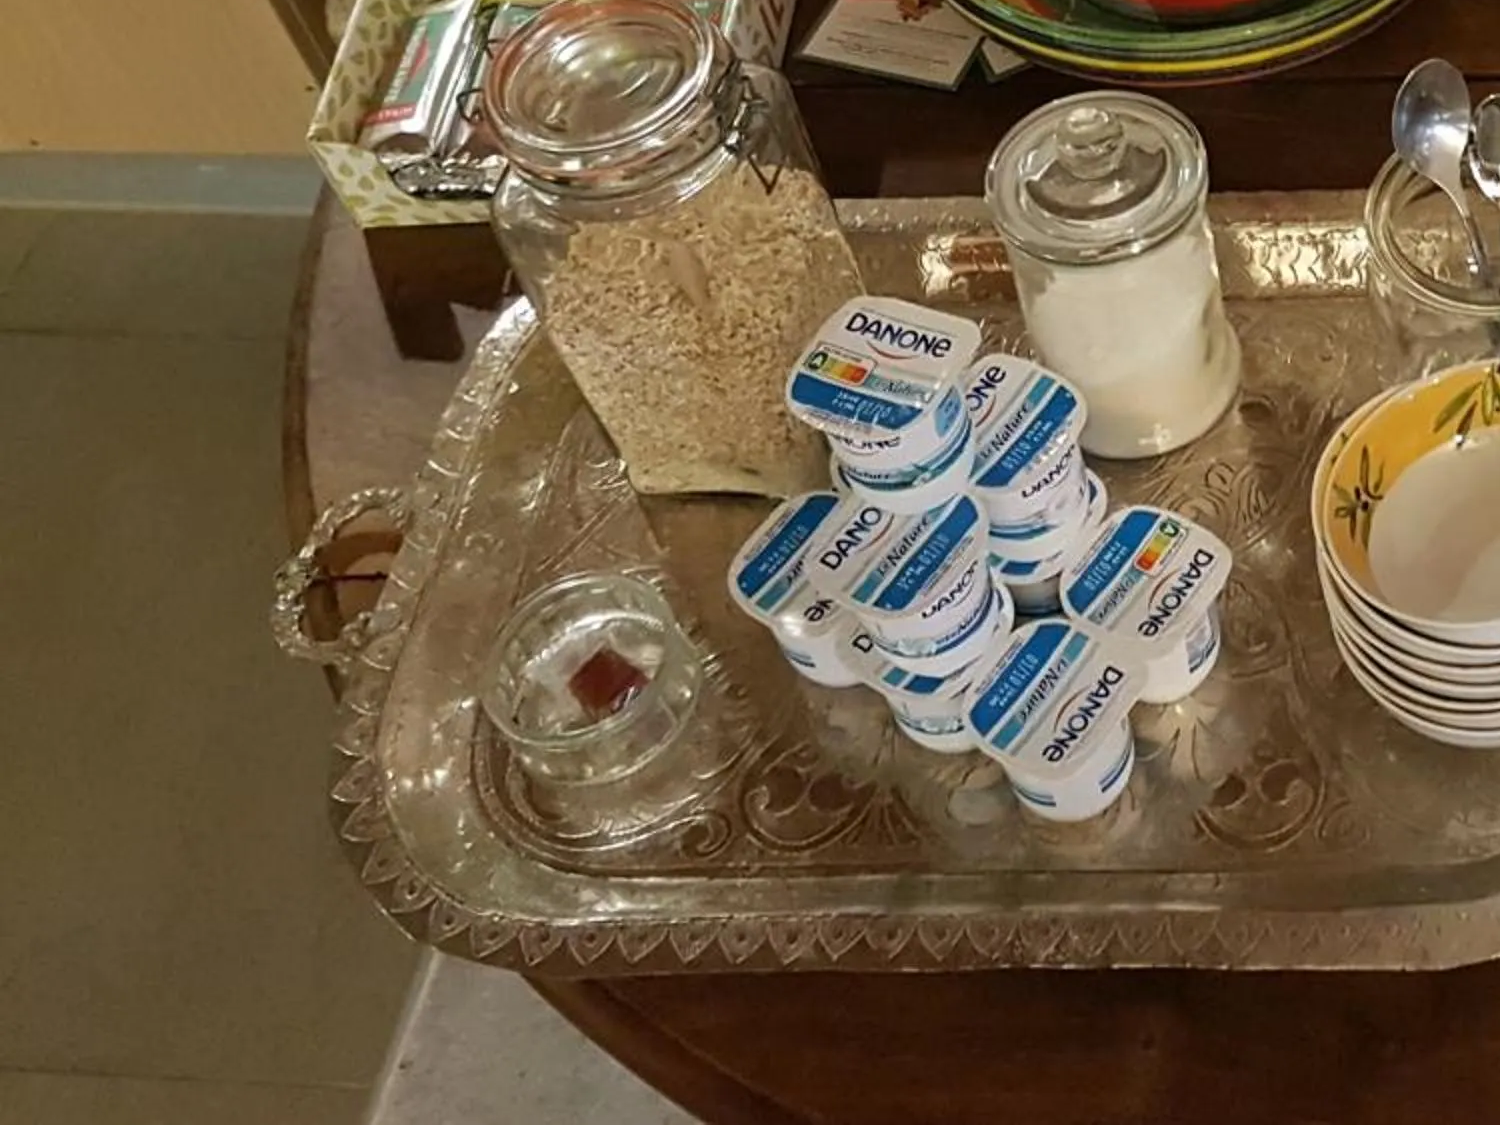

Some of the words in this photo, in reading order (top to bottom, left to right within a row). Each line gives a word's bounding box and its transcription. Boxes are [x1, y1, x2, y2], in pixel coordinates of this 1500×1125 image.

[819, 506, 883, 571] DANO
[886, 515, 931, 568] Nature
[1020, 667, 1060, 721] Nature
